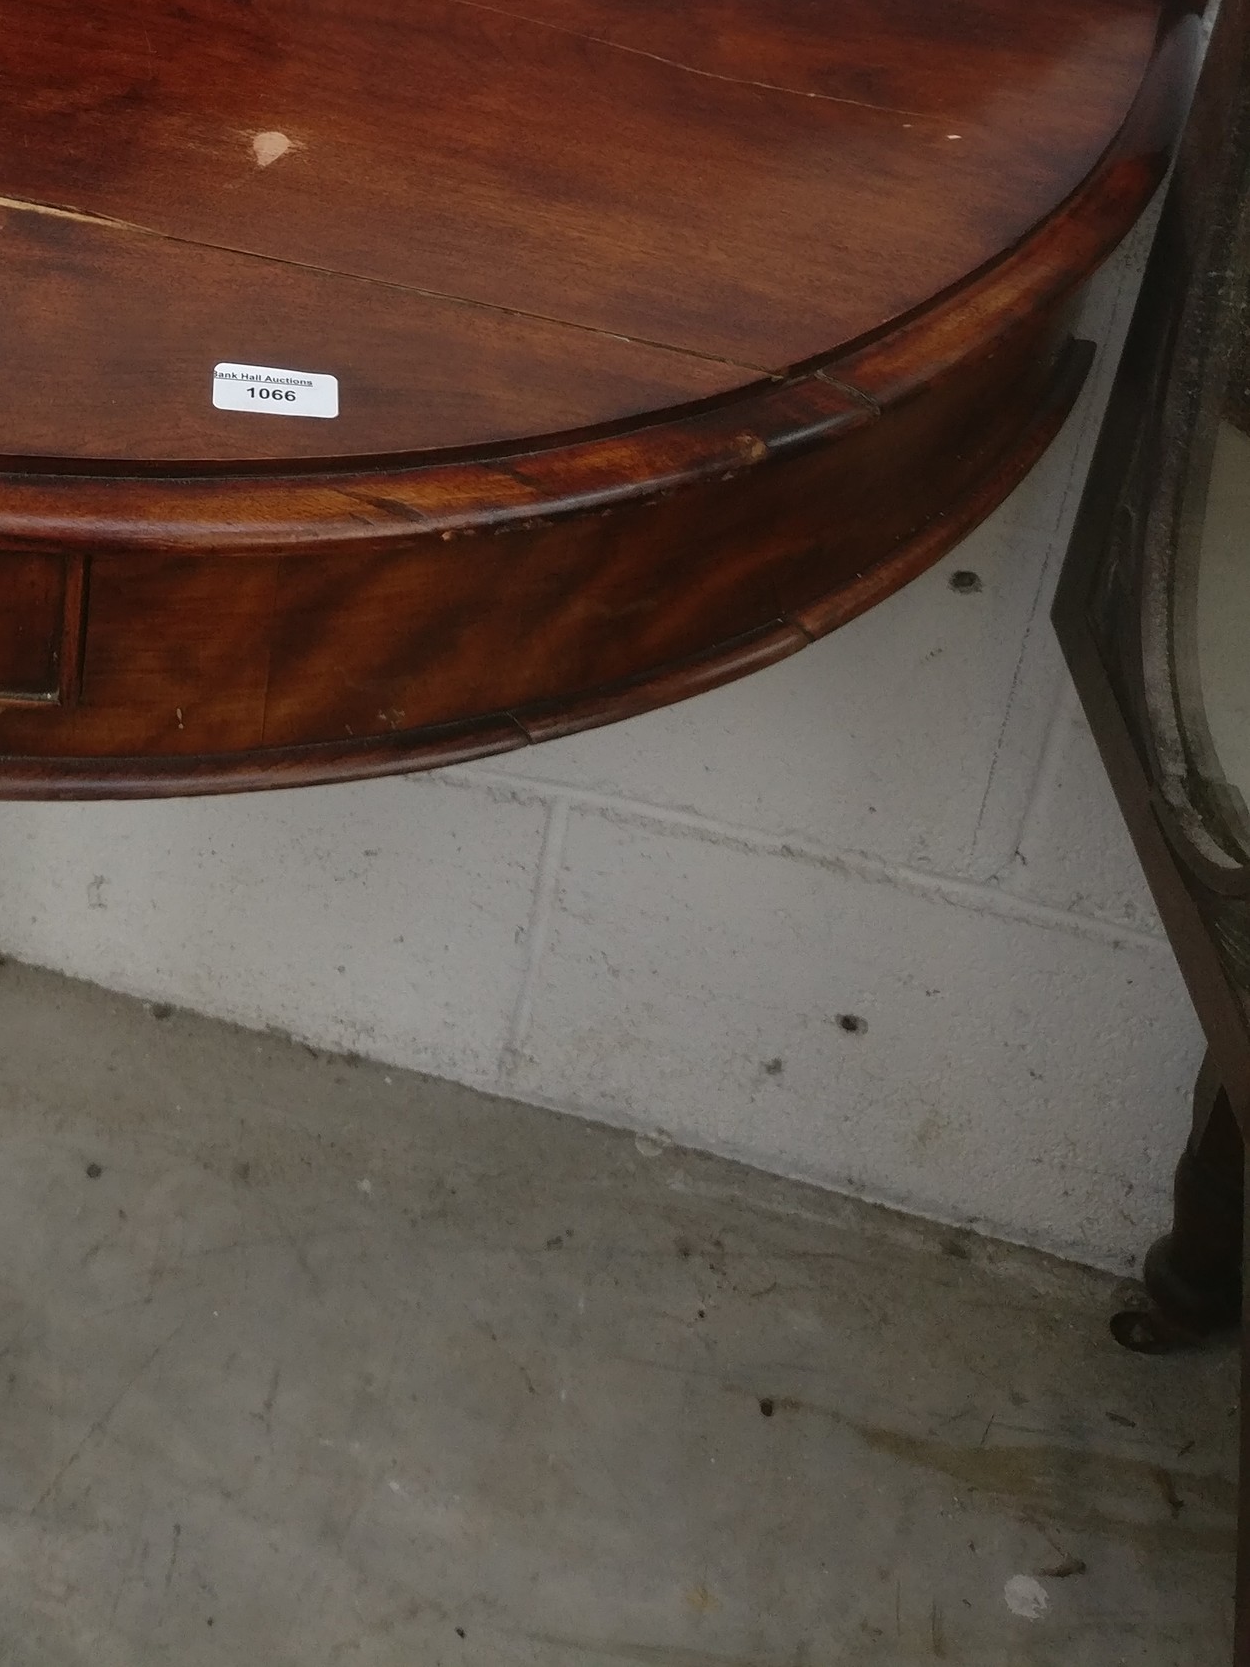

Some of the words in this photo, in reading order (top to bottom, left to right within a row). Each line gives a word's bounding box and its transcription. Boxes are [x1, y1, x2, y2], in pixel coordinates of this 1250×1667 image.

[241, 373, 261, 381] Hall
[265, 375, 313, 386] Auctions
[247, 387, 296, 402] 1066
